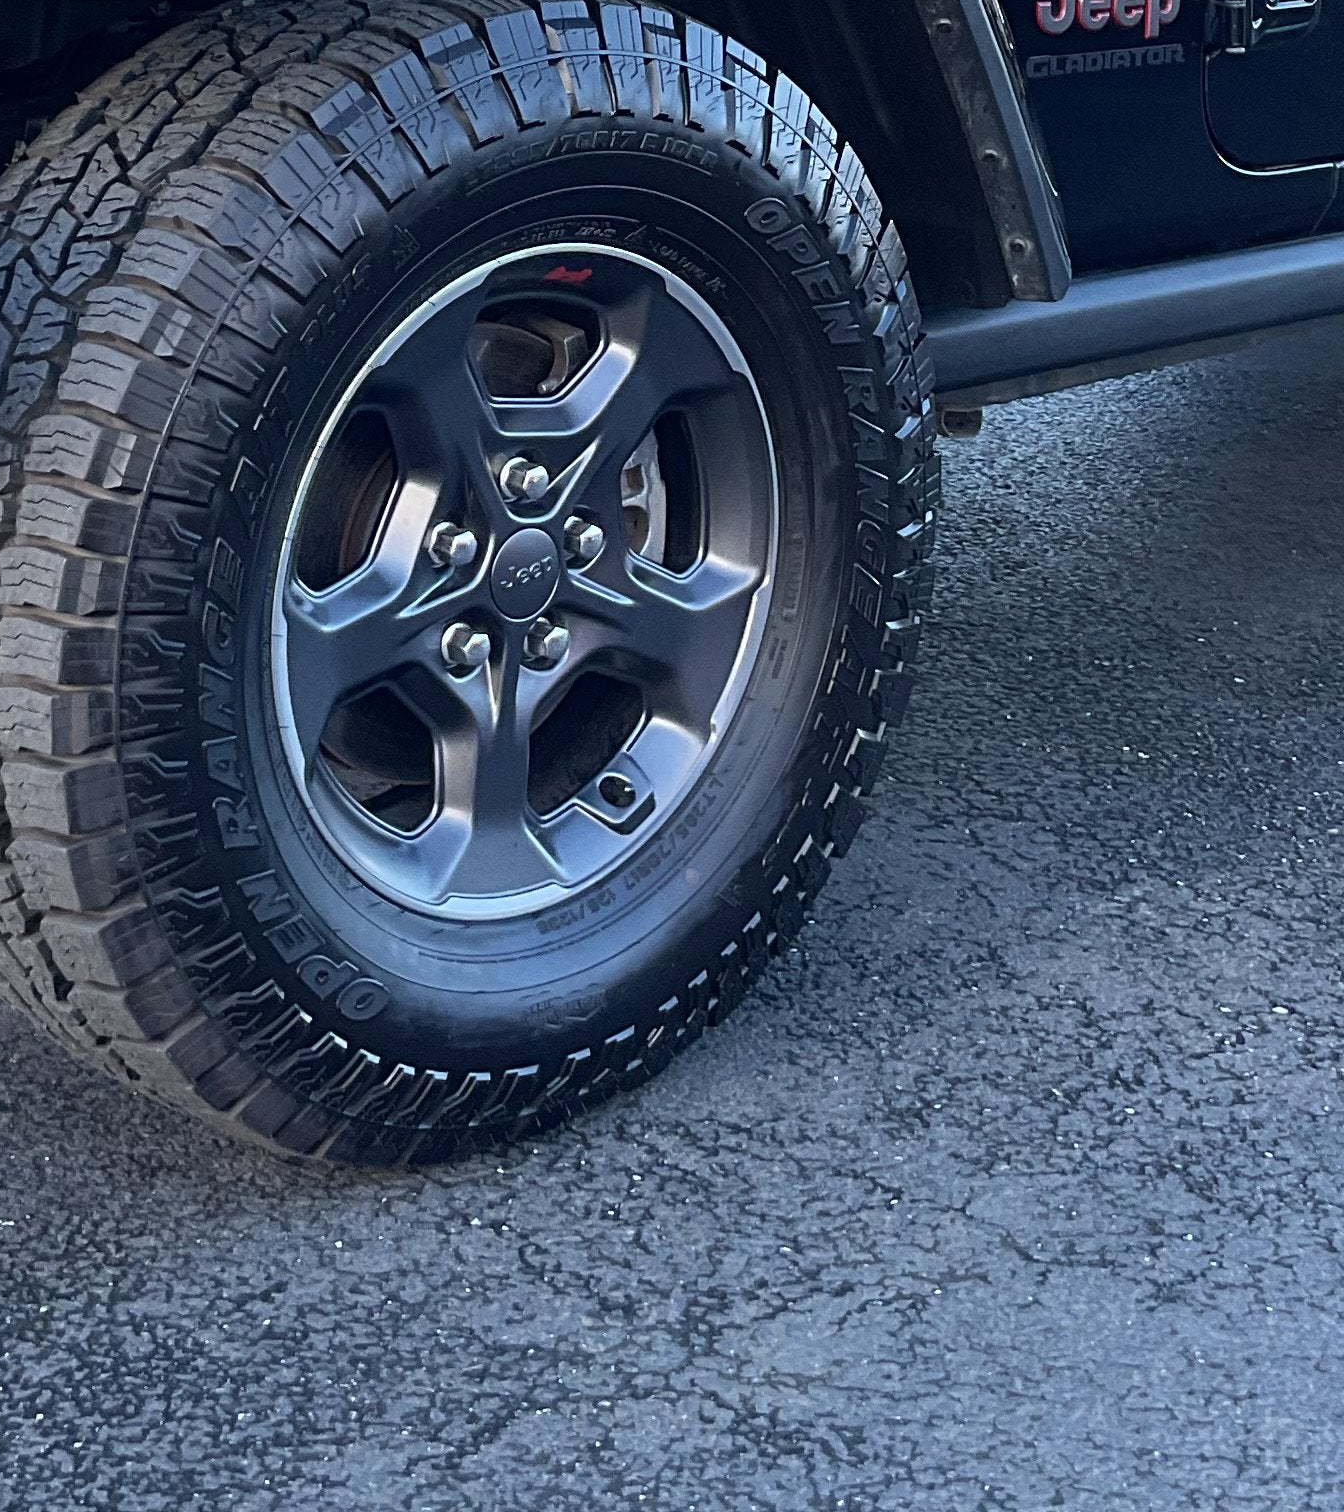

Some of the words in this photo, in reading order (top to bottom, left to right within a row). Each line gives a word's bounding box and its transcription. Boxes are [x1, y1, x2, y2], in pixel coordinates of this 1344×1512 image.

[1026, 44, 1186, 78] GLADIATOR
[743, 196, 866, 345] OPEN
[836, 364, 891, 628] RANGE
[199, 536, 263, 850] RANGE
[236, 868, 392, 1023] OPEN
